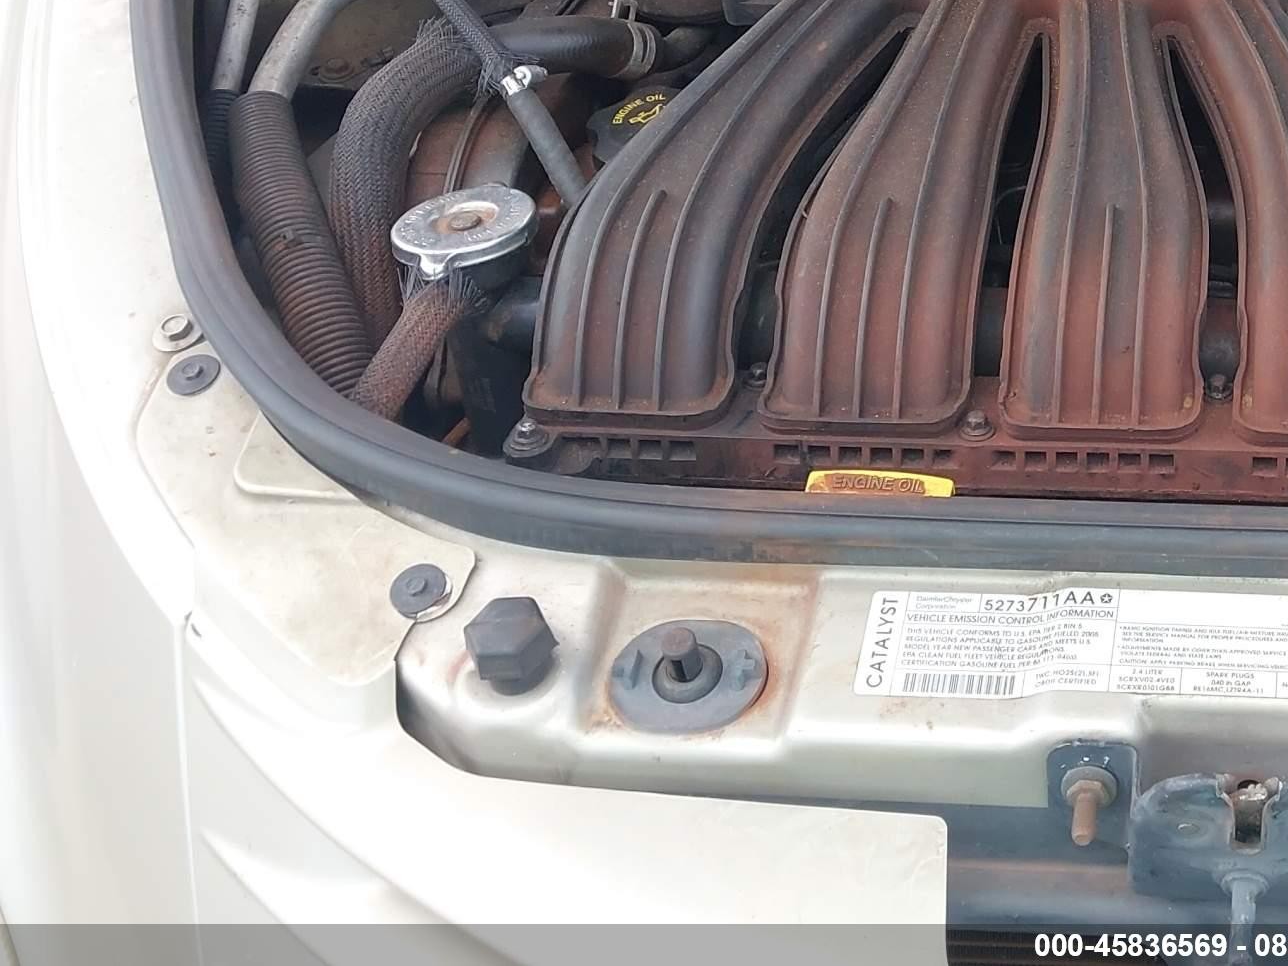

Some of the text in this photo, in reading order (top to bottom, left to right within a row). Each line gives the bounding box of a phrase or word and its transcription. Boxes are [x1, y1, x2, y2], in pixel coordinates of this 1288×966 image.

[612, 93, 667, 124] ENGINE OIL
[832, 474, 925, 493] ENGINE OIL
[984, 591, 1095, 612] 5273711AA
[907, 609, 1114, 625] VEHICLE EMISSION CONTROL INFORMATION
[866, 597, 898, 688] CATALYST
